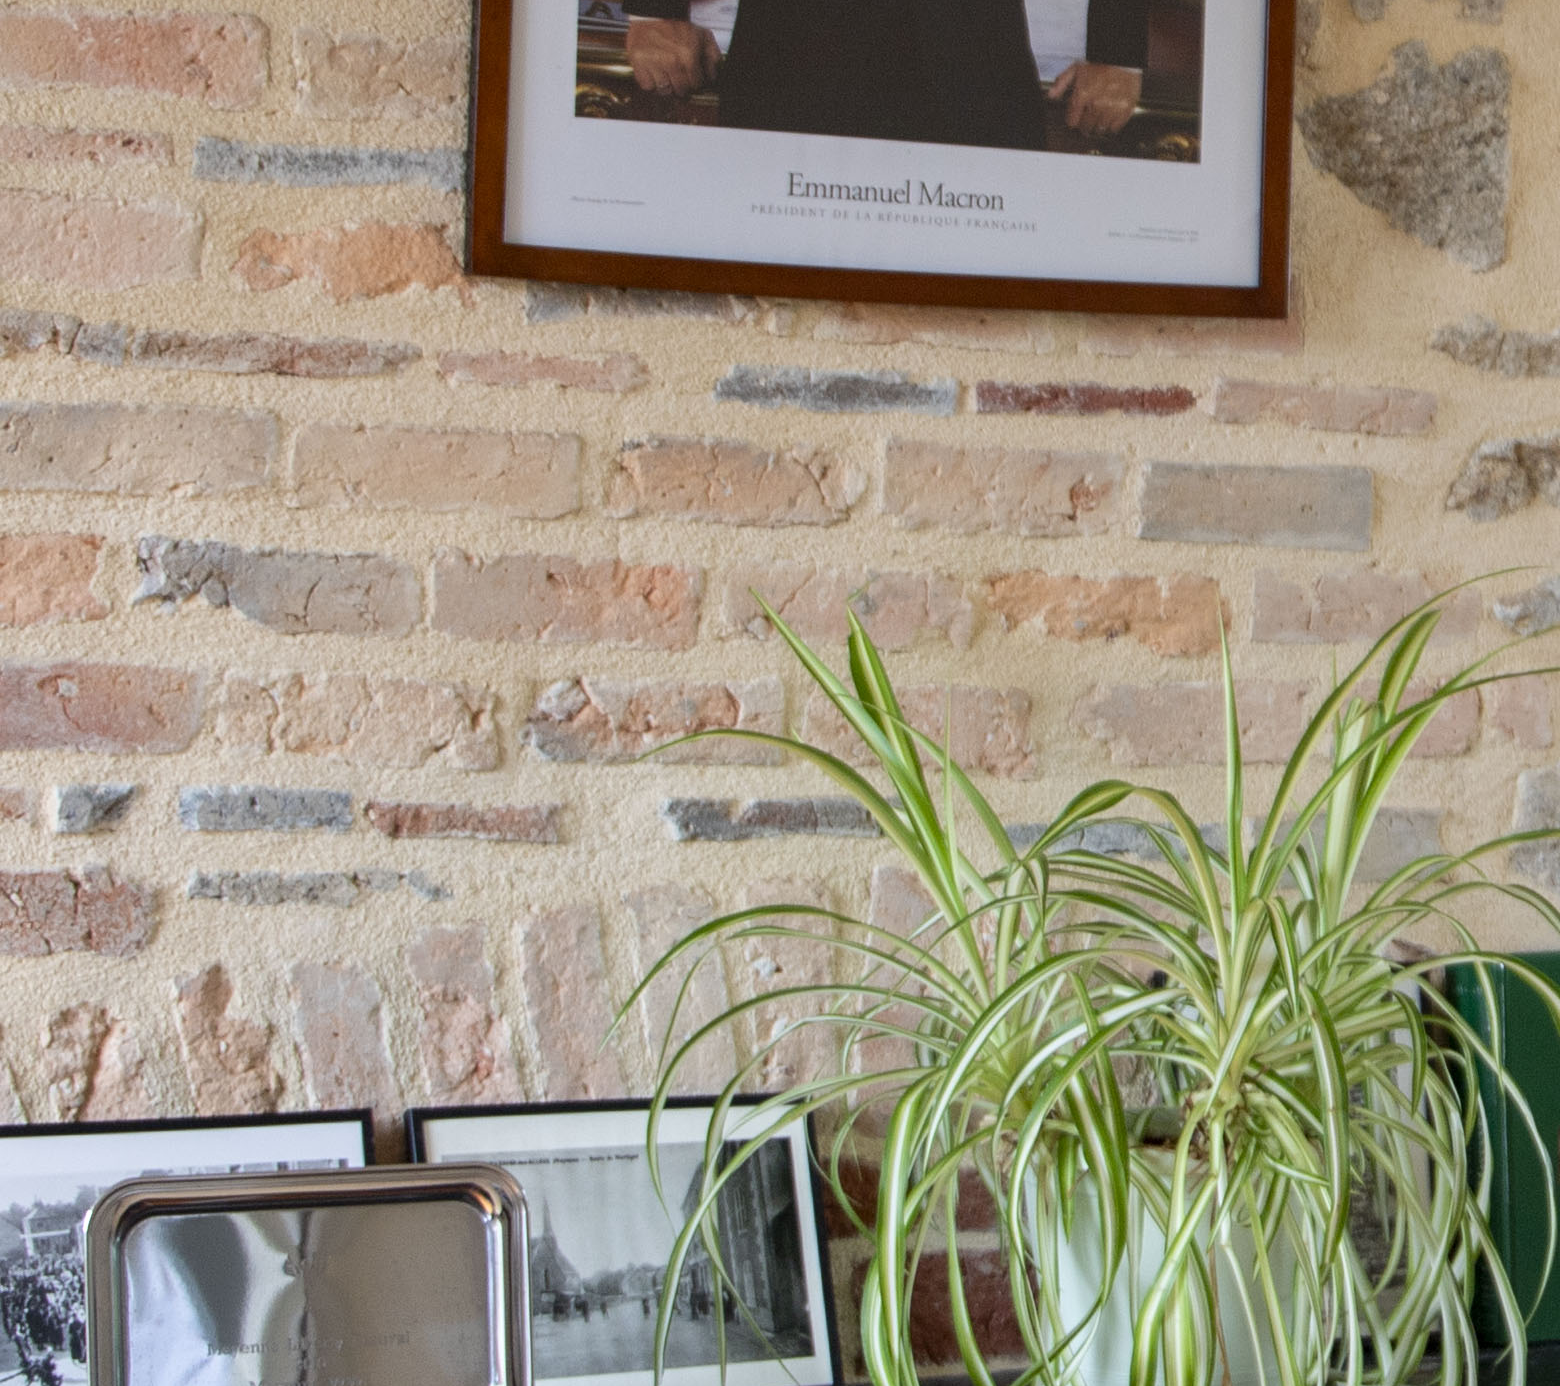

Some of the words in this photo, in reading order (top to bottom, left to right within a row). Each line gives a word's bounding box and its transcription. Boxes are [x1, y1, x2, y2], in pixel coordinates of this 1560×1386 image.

[787, 172, 911, 205] Emmanuel
[918, 180, 1005, 212] Macron
[751, 203, 827, 219] PRÉSIDENT
[833, 208, 849, 220] DE
[856, 211, 871, 221] LA
[878, 211, 959, 228] RÉPUBLIQUE
[967, 217, 1039, 234] FRANÇAISE
